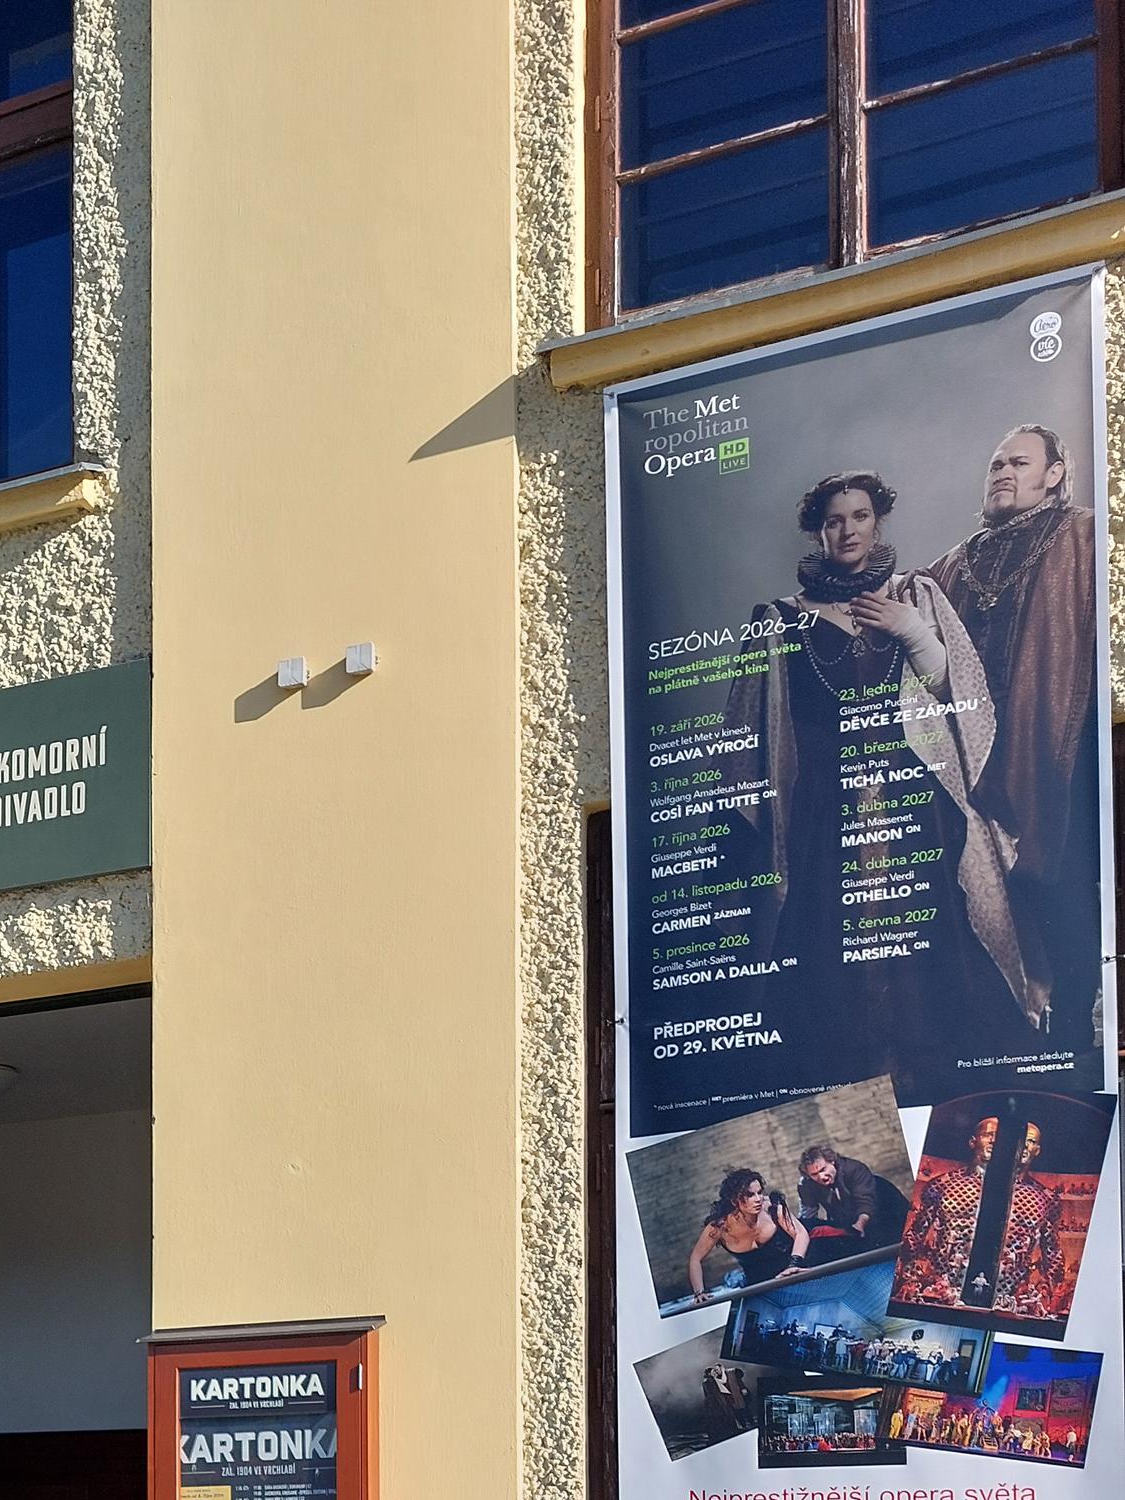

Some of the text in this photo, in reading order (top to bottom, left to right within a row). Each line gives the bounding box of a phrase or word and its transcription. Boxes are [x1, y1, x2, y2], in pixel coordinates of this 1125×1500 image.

[643, 394, 740, 430] The Met
[644, 416, 749, 454] ropolitan
[644, 446, 717, 478] Opera
[723, 442, 745, 456] HD
[723, 458, 746, 469] LIVE
[649, 627, 734, 661] SEZÓNA
[649, 642, 802, 681] Nejprestižnější opera světa
[649, 663, 770, 695] na plátně vašeho kina
[839, 690, 859, 701] 23.
[903, 673, 935, 688] 2027
[839, 695, 919, 716] Giacomo Puccini
[840, 698, 978, 733] DĚVČE ZE ZÁPADU
[651, 724, 667, 737] 19.
[694, 712, 725, 728] 2026
[649, 739, 680, 752] Dvacet
[681, 735, 693, 745] let
[694, 732, 713, 743] Met
[721, 724, 751, 737] kinech
[649, 734, 760, 768] OSLAVA VÝROČÍ
[840, 731, 945, 759] 20. března 2027
[840, 758, 890, 774] Kevin Puts
[840, 761, 947, 790] TICHÁ NOC MET
[649, 779, 770, 808] Wolfgang Amadeus Mozart
[650, 781, 661, 793] 3.
[692, 769, 722, 784] 2026
[685, 802, 713, 817] FAN
[716, 793, 760, 810] TUTTE
[763, 789, 777, 799] ON
[841, 790, 935, 816] 3. dubna 2027
[840, 812, 914, 832] Jules Massenet
[651, 836, 669, 848] 17.
[700, 824, 731, 839] 2026
[841, 824, 922, 848] MANON ON
[651, 843, 717, 863] Giuseppe Verdi
[841, 848, 944, 874] 24. dubna 2027
[651, 857, 717, 879] MACBETH
[841, 870, 915, 889] Giuseppe Verdi
[651, 871, 783, 904] od 14. listopadu 2026
[841, 881, 930, 906] OTHELLO ON
[651, 901, 713, 919] Georges Bizet
[651, 907, 751, 935] CARMEN ZÁZNAM
[842, 908, 937, 931] 5. června 2027
[653, 933, 751, 960] 5. prosince 2026
[842, 930, 919, 947] Richard Wagner
[842, 940, 930, 964] PARSIFAL ON
[652, 963, 685, 975] Camille
[652, 957, 798, 991] SAMSON A DALILA ON
[653, 1012, 762, 1040] PŘEDPRODEJ
[653, 1029, 783, 1060] OD 29. KVĚTNA
[957, 1060, 972, 1069] Pro
[996, 1055, 1038, 1065] informace
[1040, 1051, 1074, 1062] sledujte
[1017, 1062, 1075, 1074] metopera.cz
[760, 1090, 775, 1099] Met
[190, 1373, 325, 1402] KARTONKA
[237, 1465, 252, 1477] 1904
[263, 1463, 296, 1475] VRCHLABÍ
